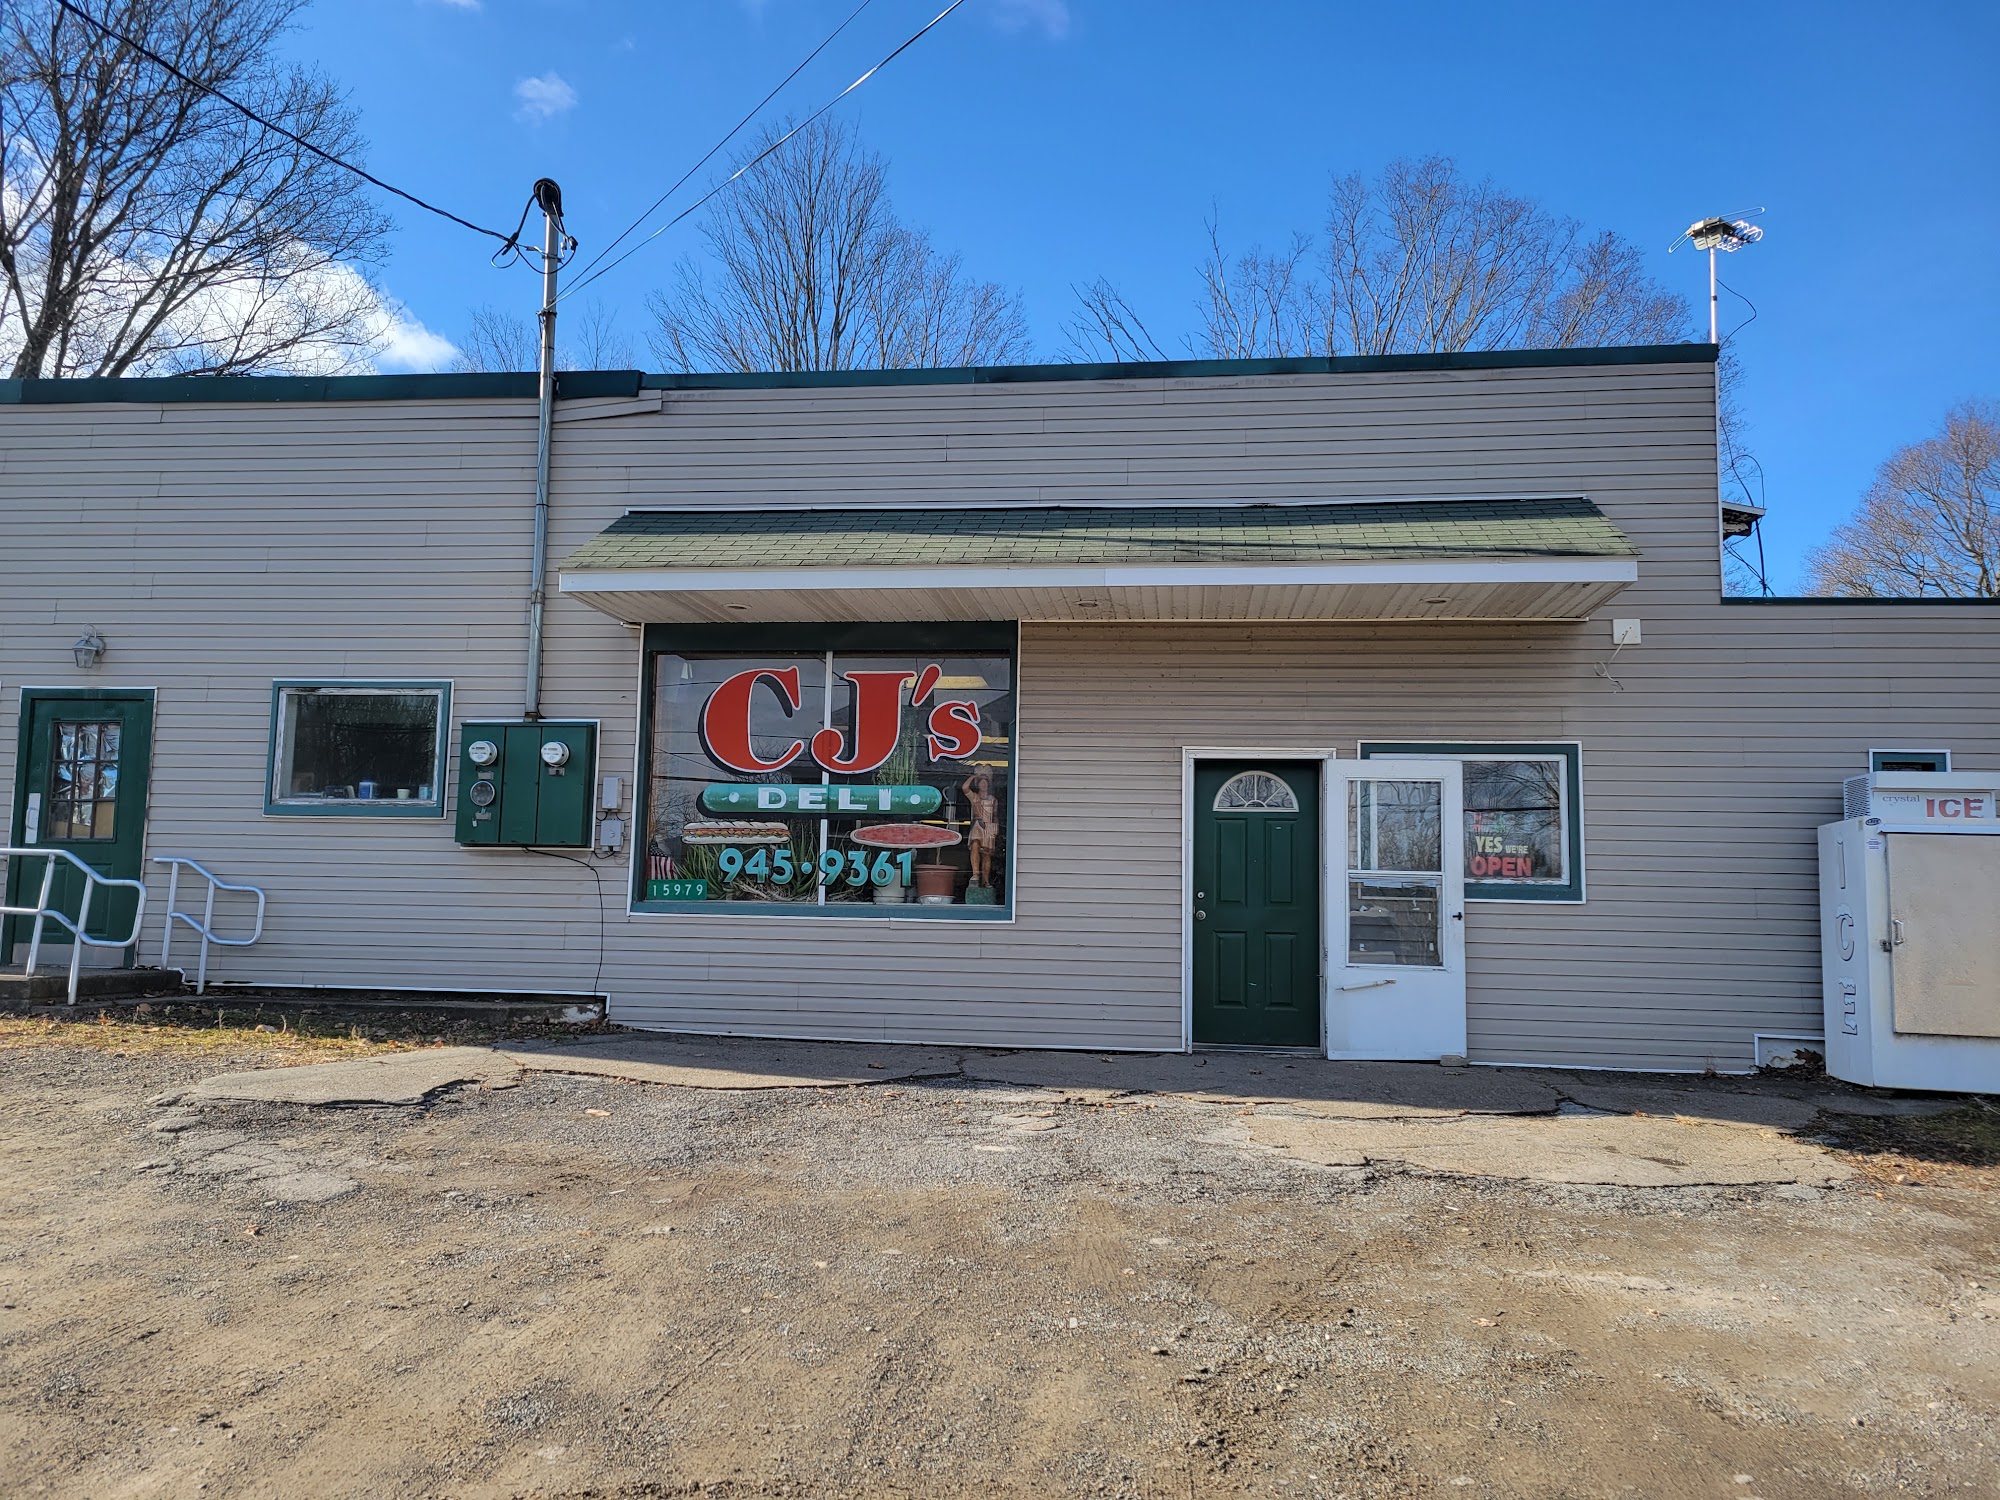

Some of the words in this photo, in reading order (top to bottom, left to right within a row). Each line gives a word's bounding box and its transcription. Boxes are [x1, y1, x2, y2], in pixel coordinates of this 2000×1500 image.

[699, 664, 982, 774] CJ's
[757, 786, 892, 811] DELI
[1882, 794, 1920, 805] crystal
[1925, 798, 1984, 819] ICE
[1475, 835, 1503, 853] YES
[1505, 844, 1529, 854] WE'RE
[1471, 855, 1532, 877] OPEN
[652, 884, 703, 897] 15979
